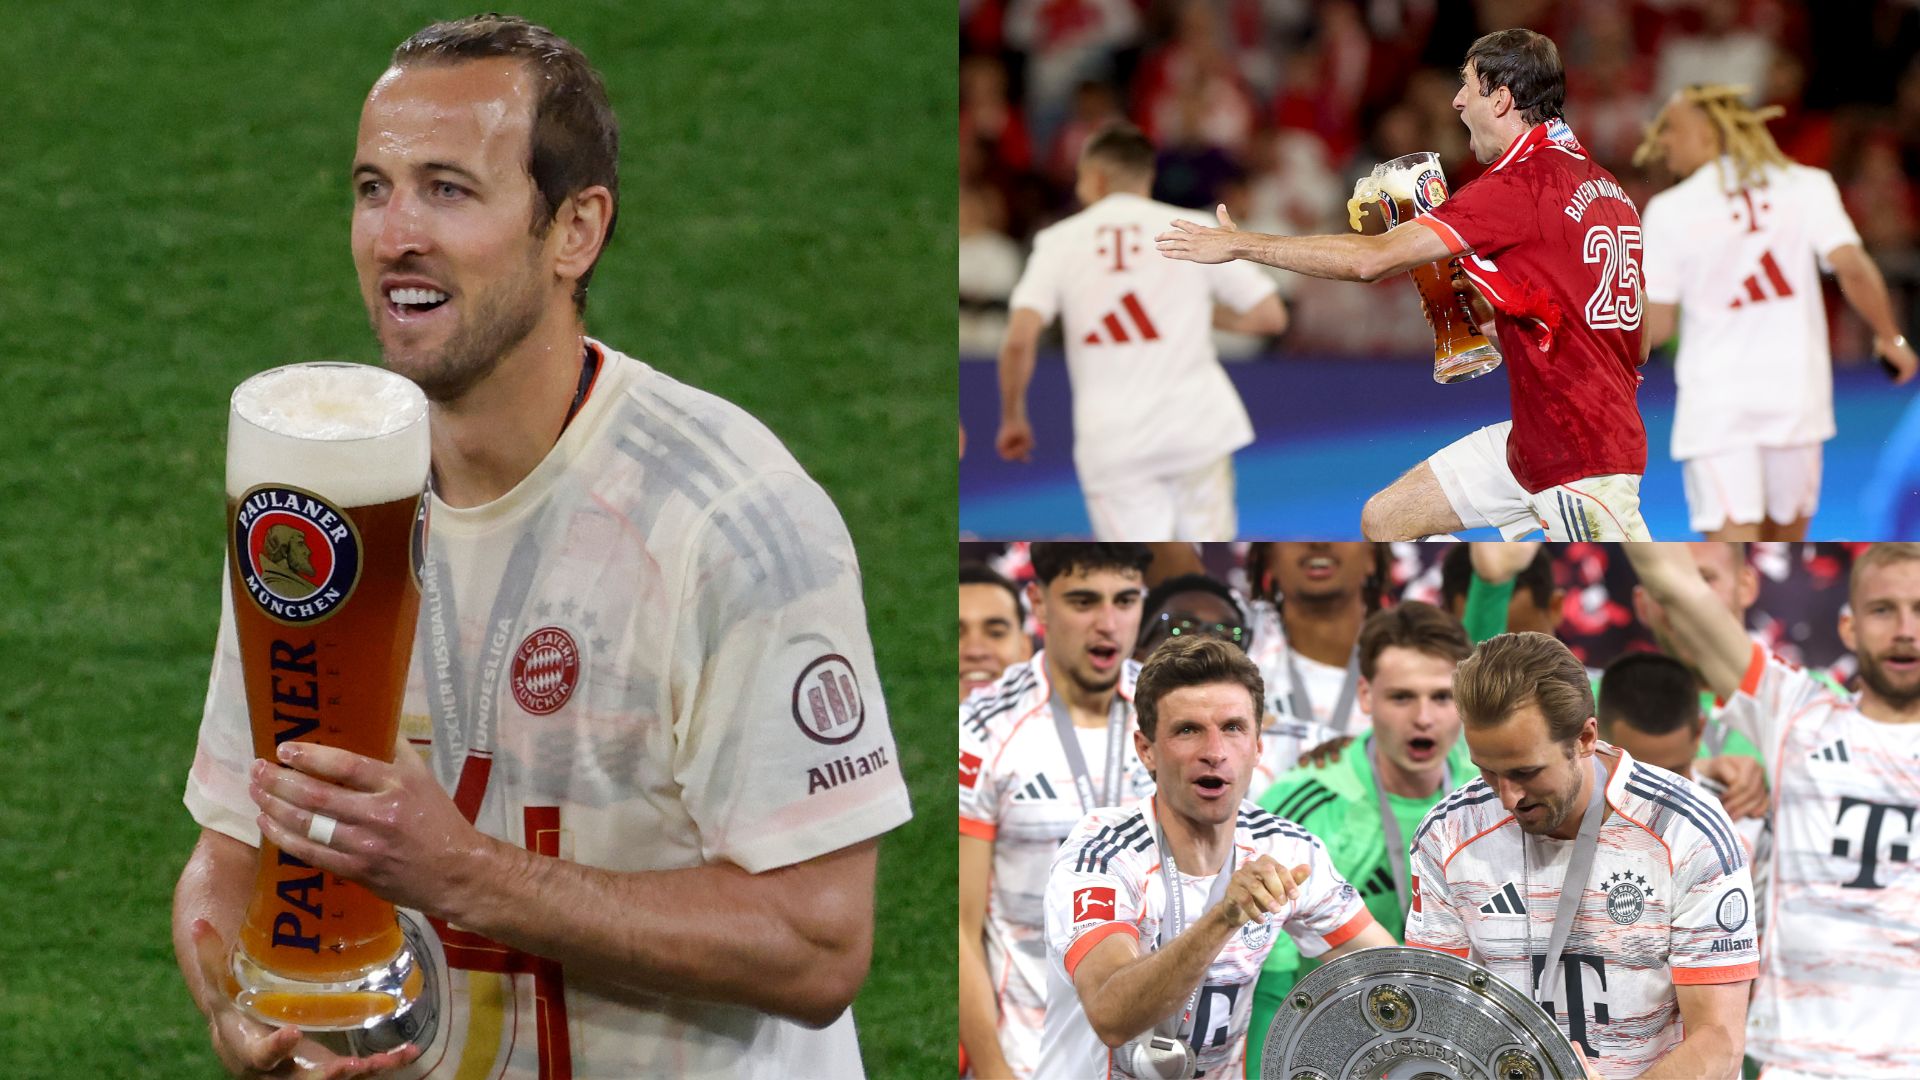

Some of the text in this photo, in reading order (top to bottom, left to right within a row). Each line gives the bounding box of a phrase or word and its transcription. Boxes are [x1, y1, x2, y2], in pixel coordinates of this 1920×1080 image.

[1564, 180, 1600, 223] BAYERN
[1095, 223, 1142, 272] T
[1583, 225, 1643, 331] 25
[239, 491, 349, 543] PAULANER
[518, 633, 574, 667] FC BAYERN
[476, 618, 512, 751] UNDESLIGA
[807, 746, 889, 795] Allianz
[1832, 796, 1919, 890] T
[1172, 880, 1182, 937] ALLMEISTER
[1610, 886, 1642, 903] FC BAYERN
[1711, 938, 1753, 953] Allianz
[1531, 953, 1610, 1058] T
